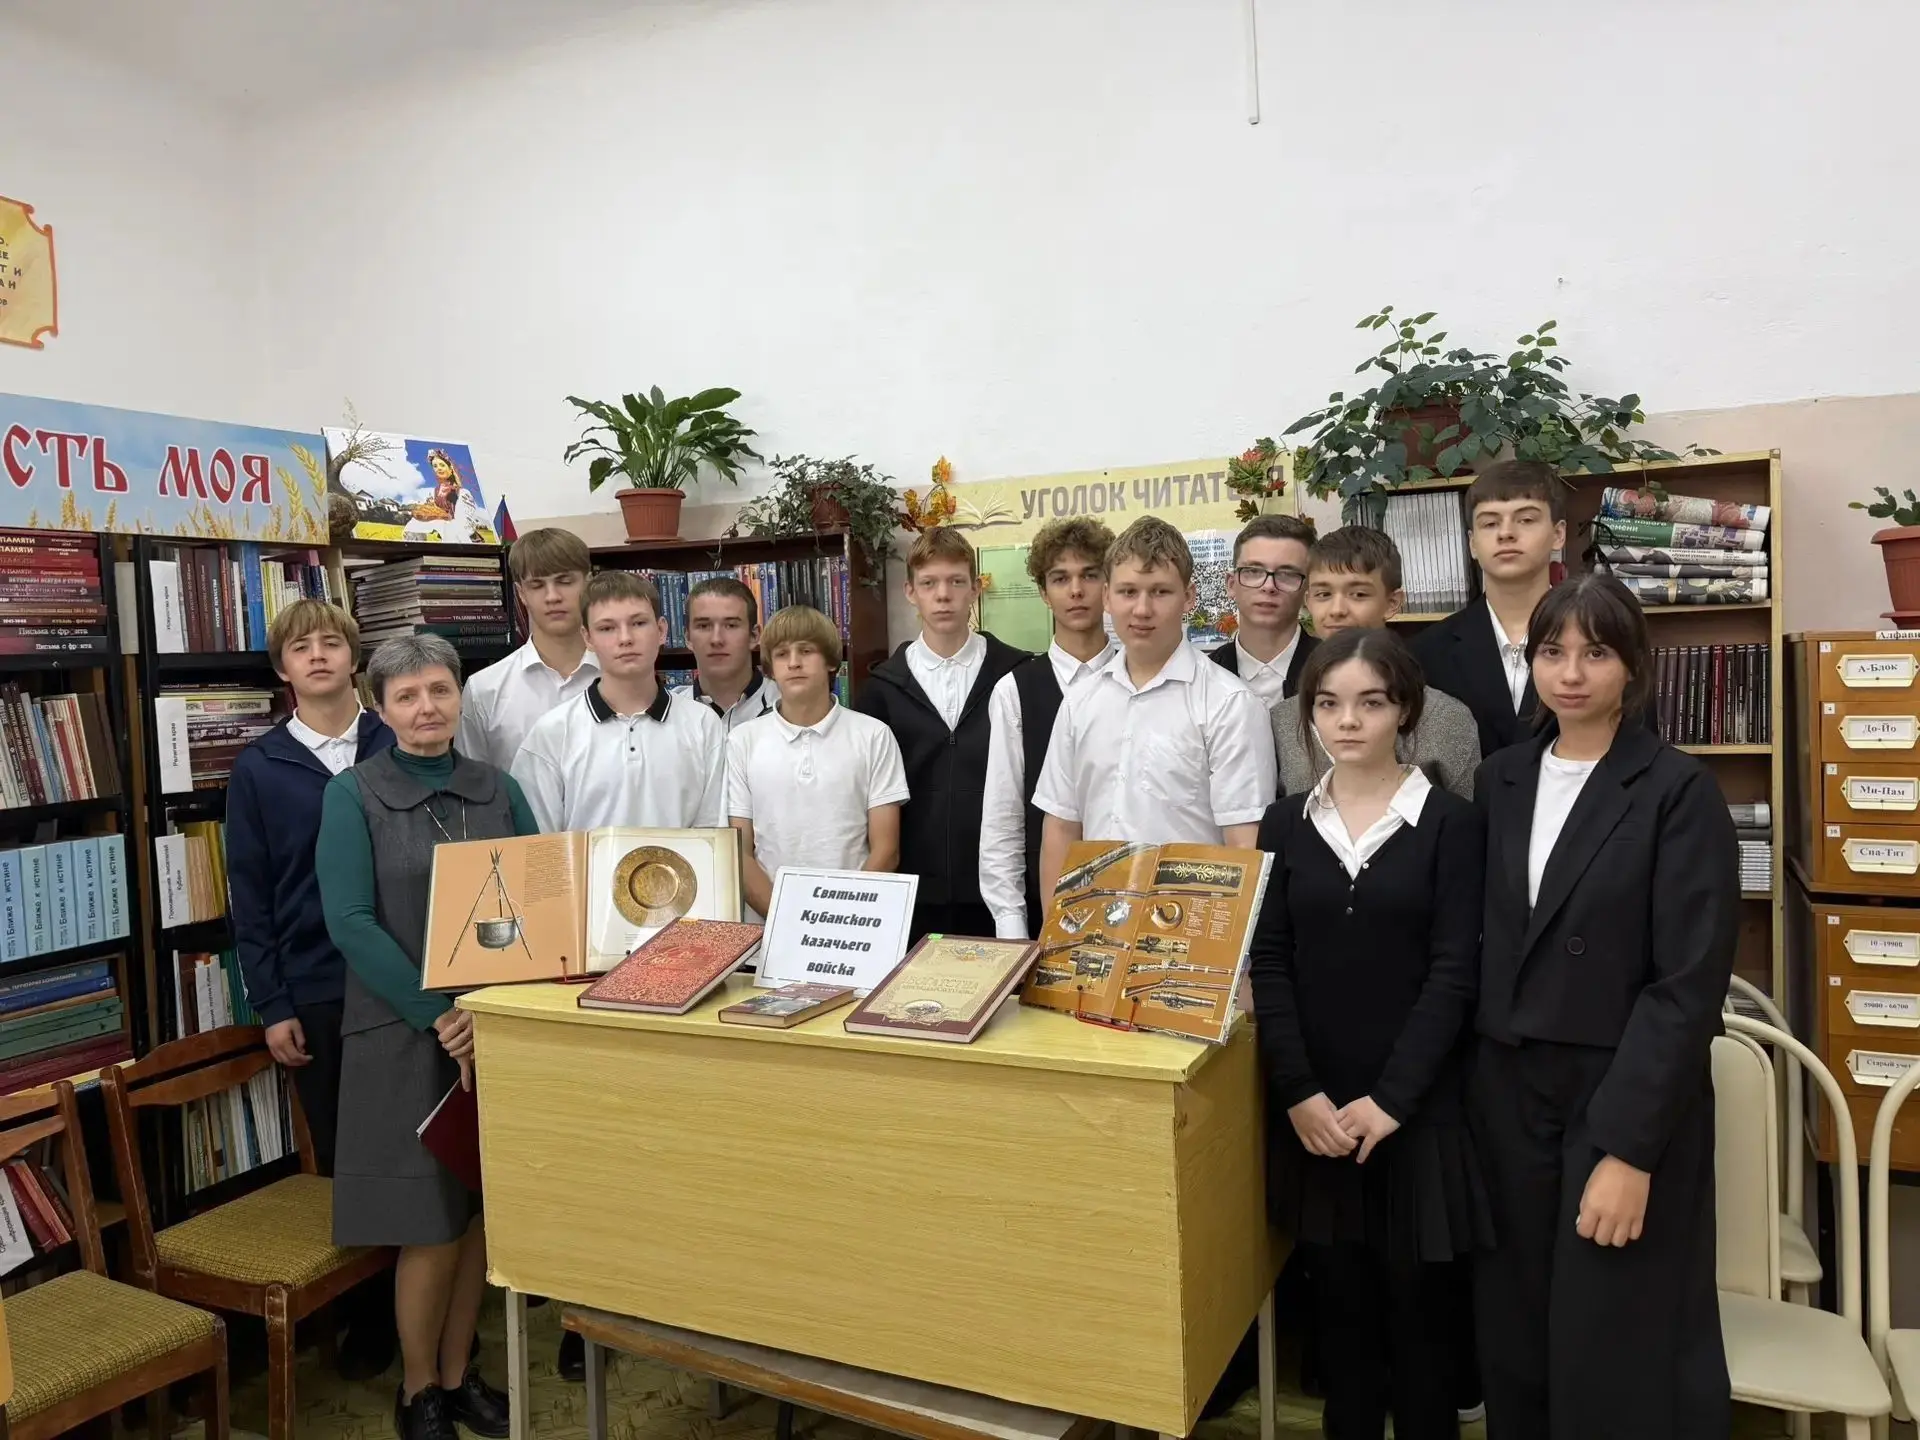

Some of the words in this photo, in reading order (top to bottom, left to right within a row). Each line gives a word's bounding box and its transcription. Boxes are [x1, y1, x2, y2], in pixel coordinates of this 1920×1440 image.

[158, 446, 272, 504] МОЯ
[1020, 481, 1127, 520] УГОЛОК
[1132, 465, 1284, 509] ЧИТАТЯ
[1187, 538, 1226, 546] СТОЛКНУИСЬ
[57, 628, 89, 636] фрнта
[68, 643, 92, 651] фрнта
[1858, 663, 1899, 673] А-Блок
[33, 858, 41, 889] истине
[56, 853, 64, 884] истине
[85, 848, 93, 880] истине
[108, 845, 117, 876] истине
[3, 861, 12, 893] истине
[88, 890, 96, 919] Ближе
[112, 887, 120, 915] Ближе
[812, 886, 879, 903] Святыни
[6, 905, 16, 936] Ближе
[34, 901, 43, 930] Ближе
[59, 896, 68, 926] Ближе
[800, 909, 882, 928] Кубанского
[801, 934, 871, 953] казачьего
[806, 961, 856, 977] войска
